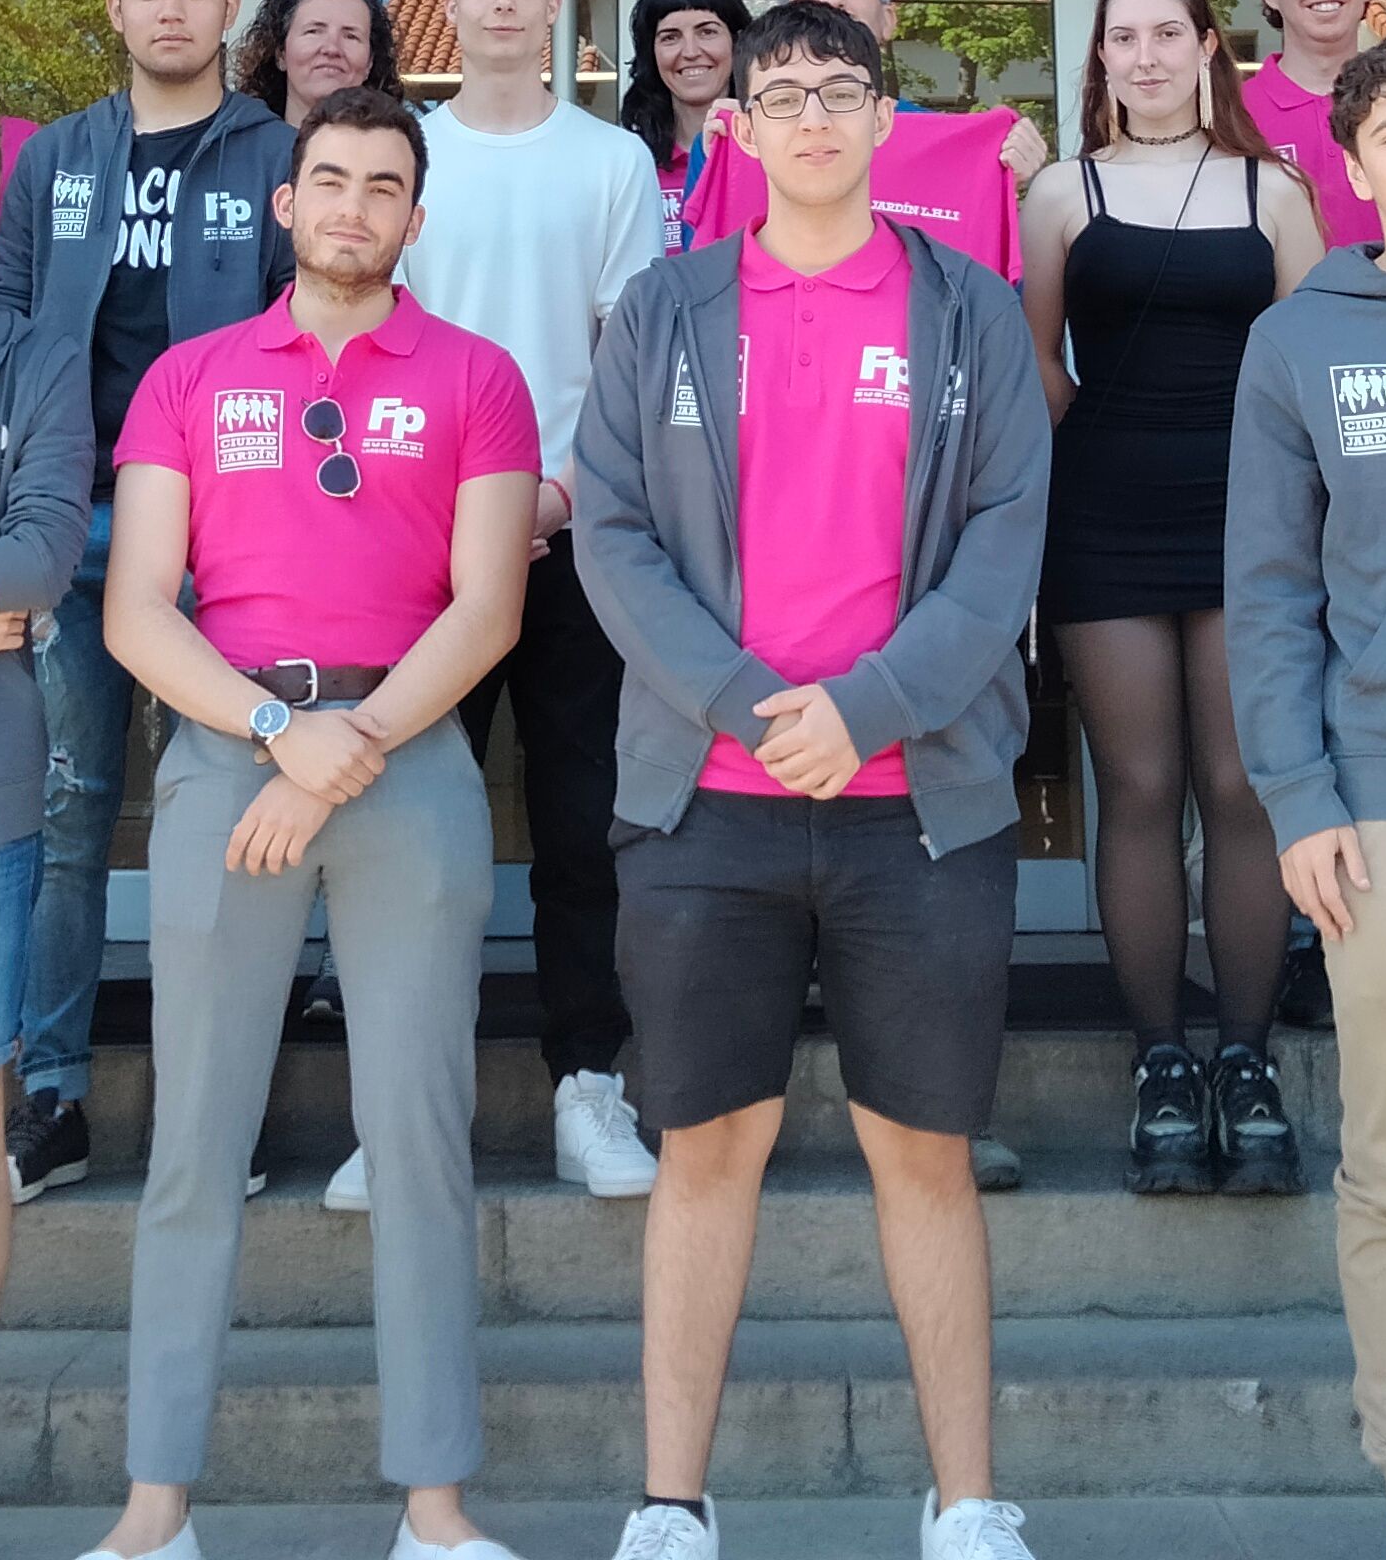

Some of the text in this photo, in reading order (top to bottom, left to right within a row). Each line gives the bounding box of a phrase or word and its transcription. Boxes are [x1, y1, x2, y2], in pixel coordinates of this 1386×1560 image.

[205, 192, 252, 228] Fp
[367, 397, 426, 440] Fp
[220, 436, 278, 448] CIUDAD
[220, 449, 278, 463] JARDÍN
